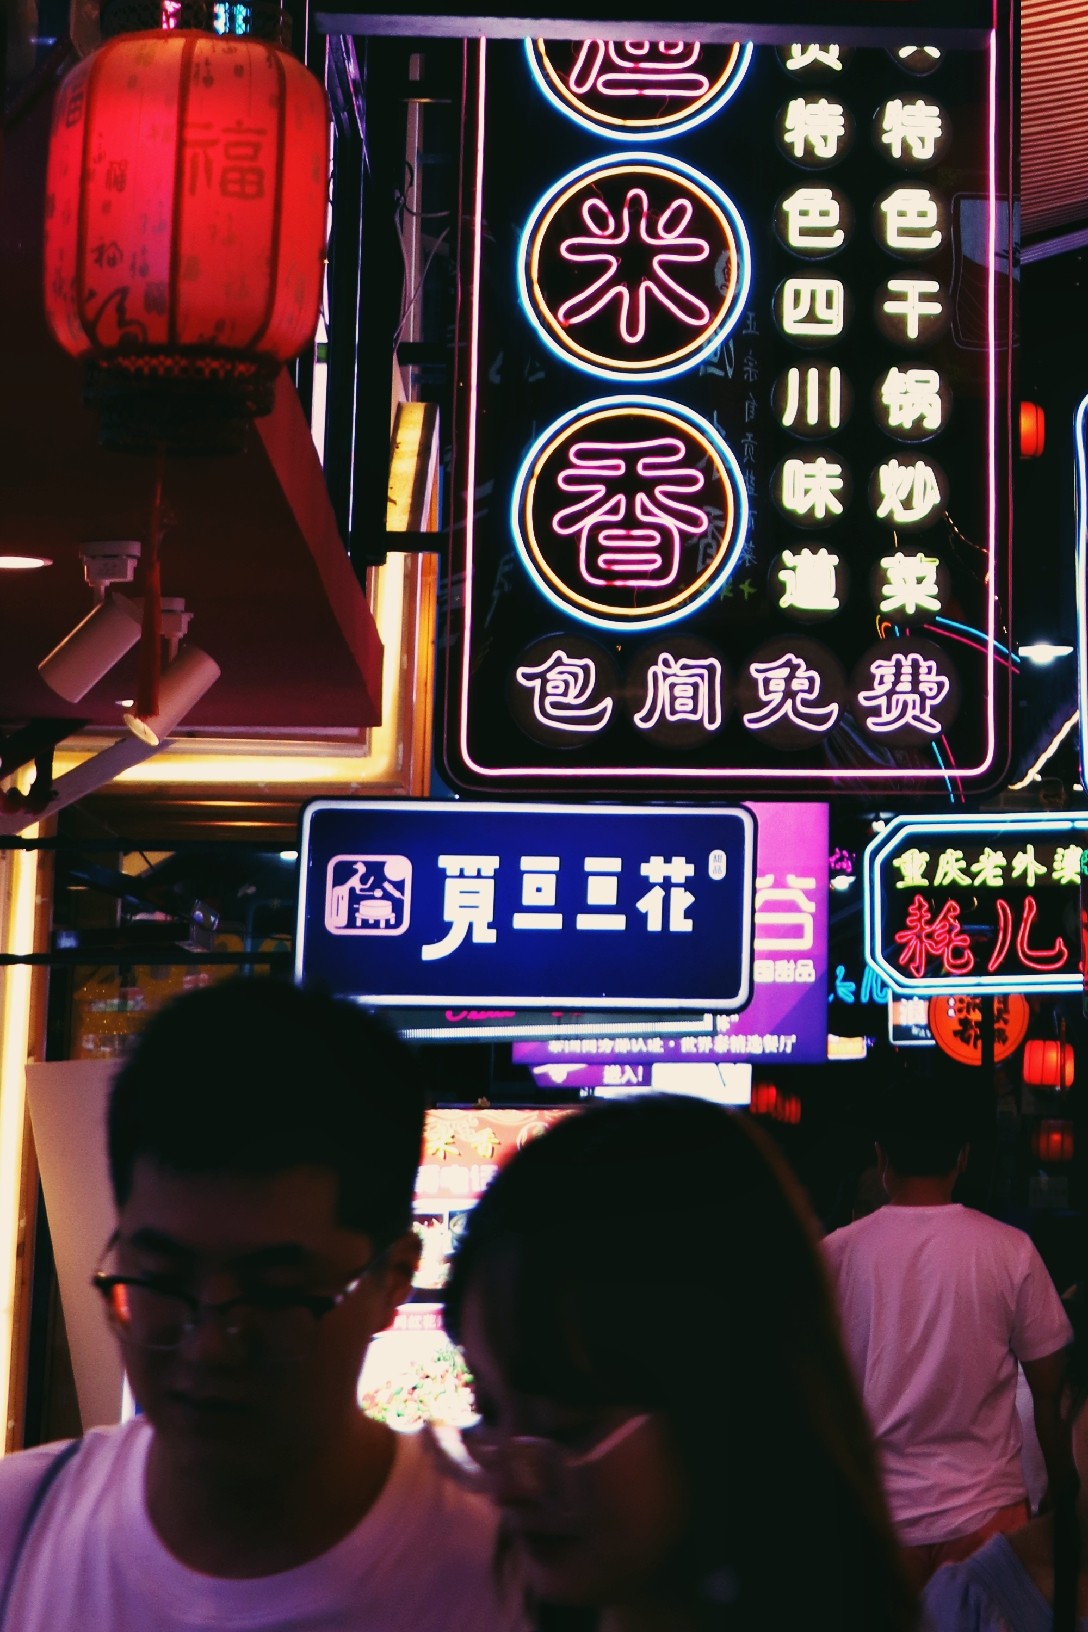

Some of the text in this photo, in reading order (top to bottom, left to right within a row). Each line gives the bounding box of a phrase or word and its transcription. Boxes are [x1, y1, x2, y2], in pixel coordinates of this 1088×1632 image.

[876, 45, 943, 615] 特色干锅炒菜
[517, 648, 950, 736] 包间免费
